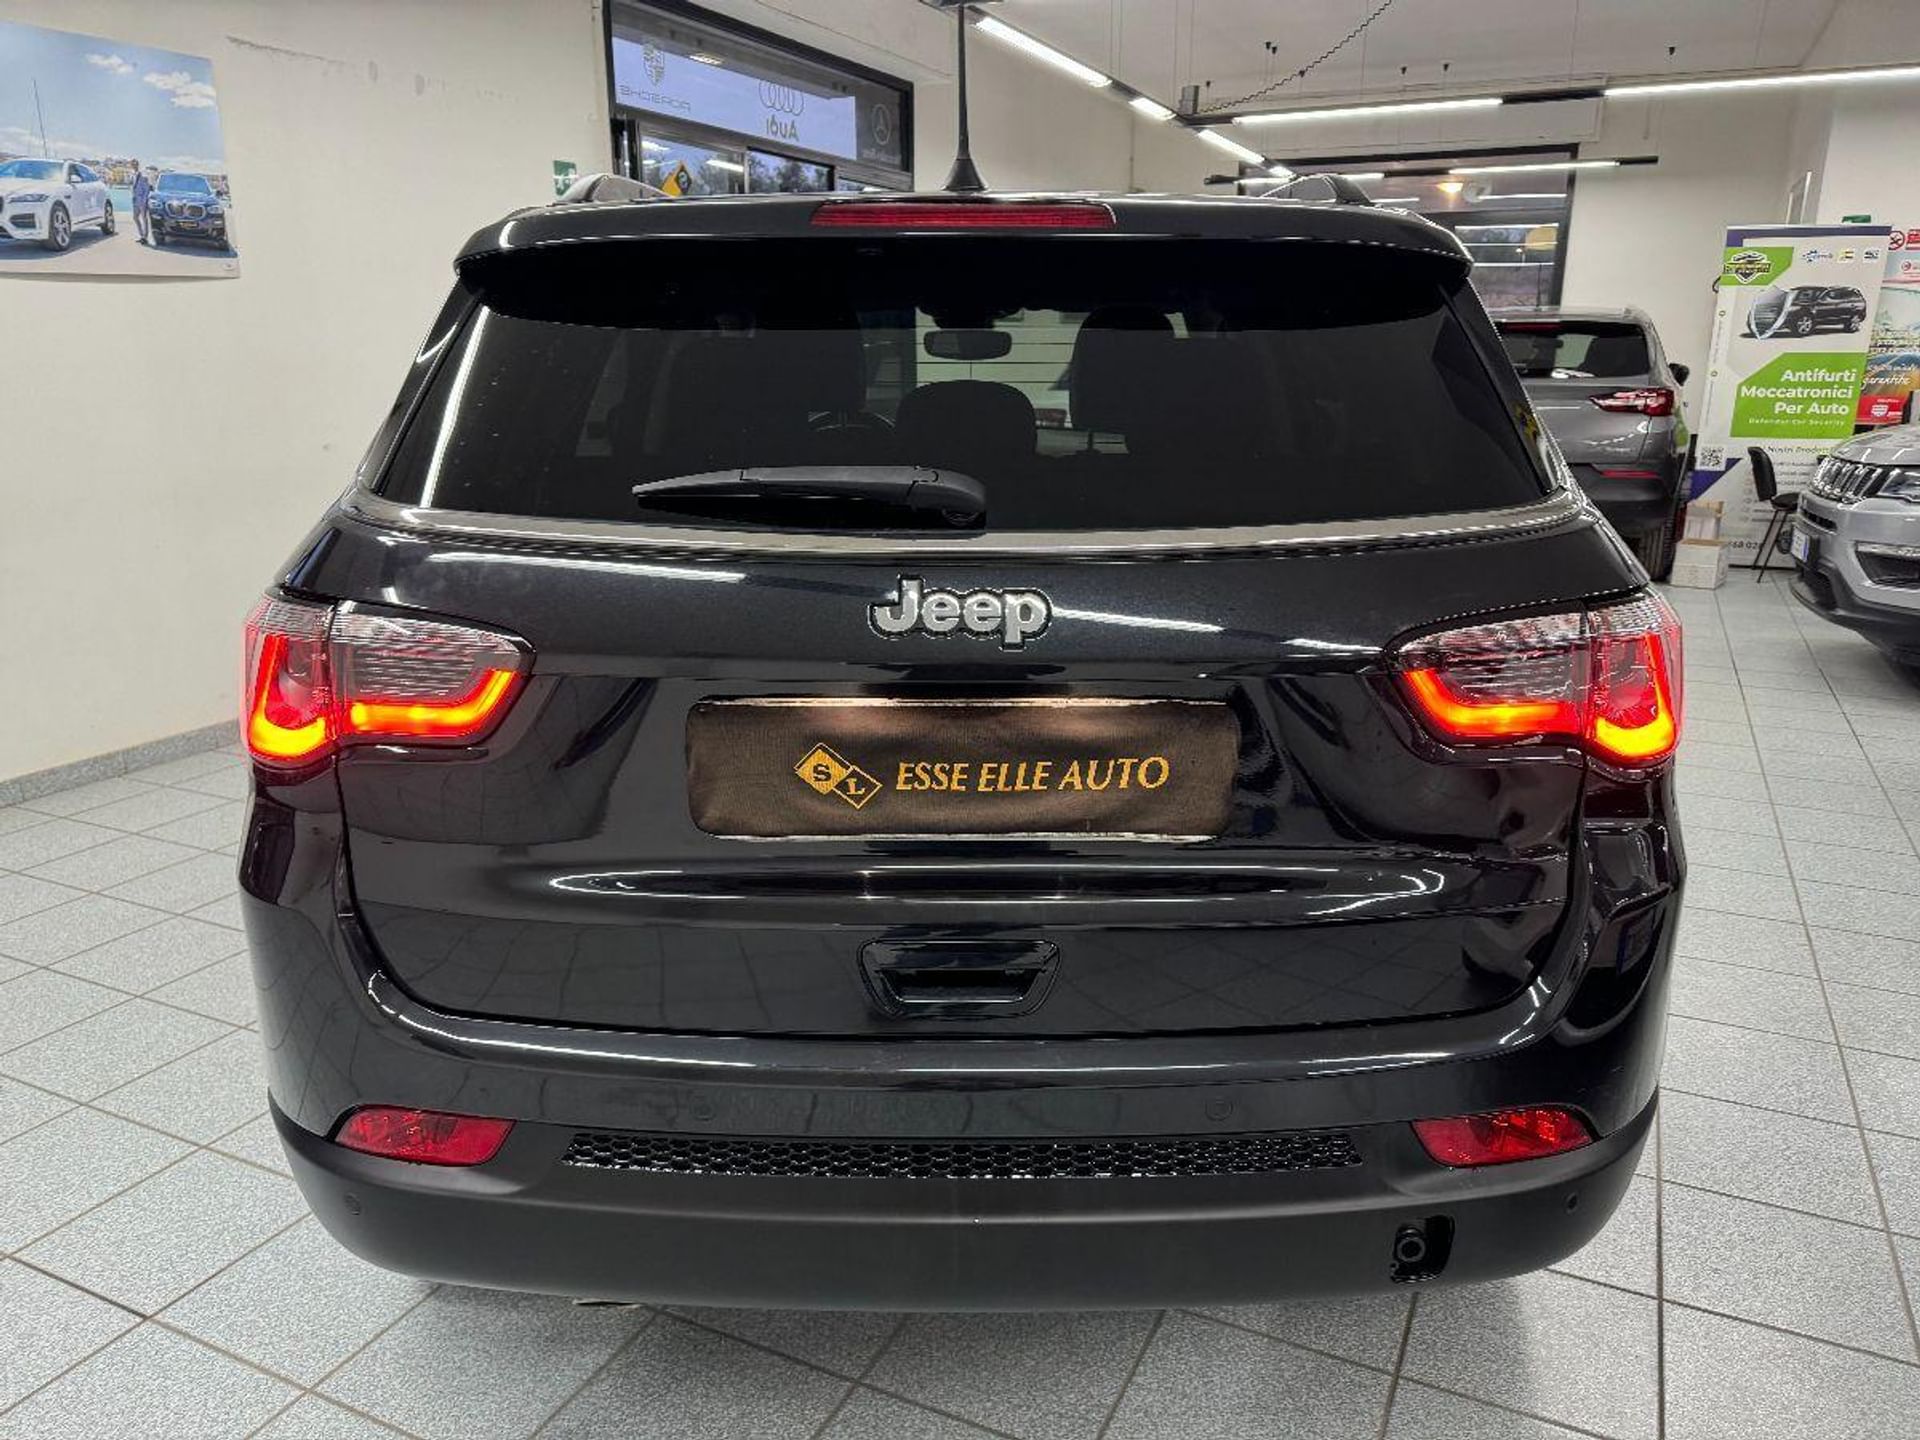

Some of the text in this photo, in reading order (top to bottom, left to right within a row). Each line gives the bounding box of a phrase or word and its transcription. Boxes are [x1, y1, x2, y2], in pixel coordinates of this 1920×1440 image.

[1780, 368, 1857, 383] Antifurti
[1740, 384, 1854, 400] Meccatronici
[1774, 401, 1850, 415] Per Auto
[868, 575, 1052, 651] Jeep
[812, 763, 866, 795] S L
[896, 756, 1170, 793] ESSE ELLE AUTO
